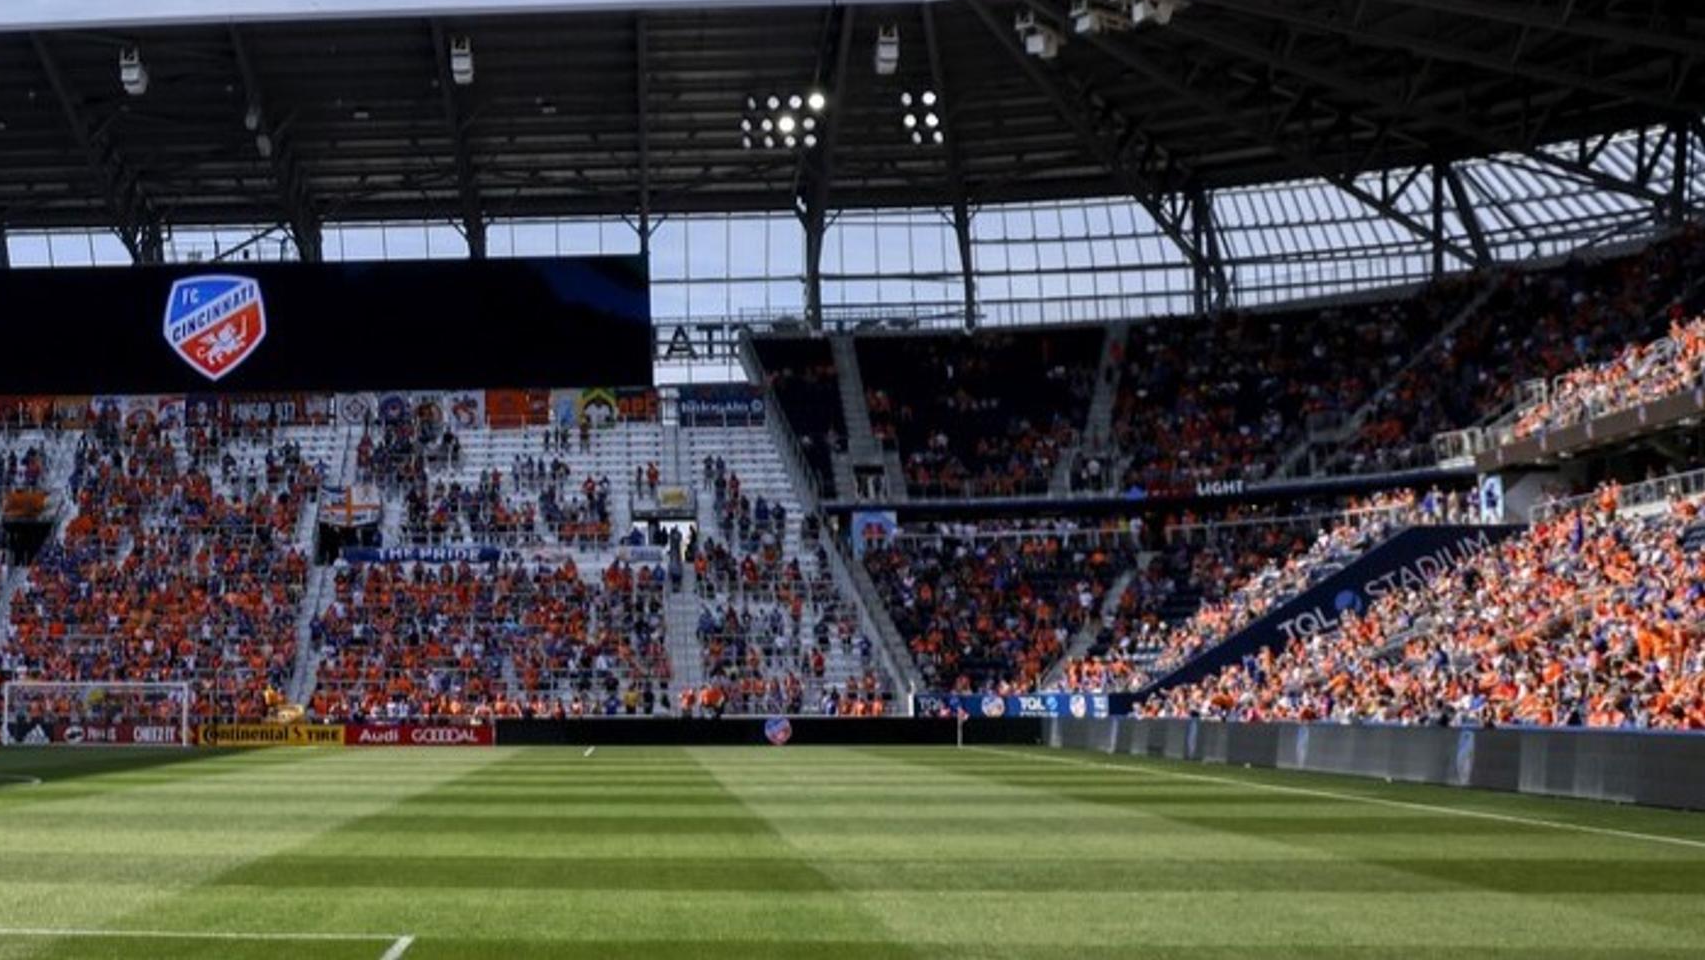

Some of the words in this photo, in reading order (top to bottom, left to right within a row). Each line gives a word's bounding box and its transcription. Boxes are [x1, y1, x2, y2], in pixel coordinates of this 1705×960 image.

[182, 287, 199, 304] FC
[173, 283, 255, 343] CINCINNATI
[1197, 479, 1244, 496] LIGHT
[419, 548, 481, 561] PRIDE
[1277, 606, 1340, 639] TQL
[1019, 696, 1046, 711] TQL
[308, 727, 340, 741] TIRE
[358, 725, 399, 742] Audi
